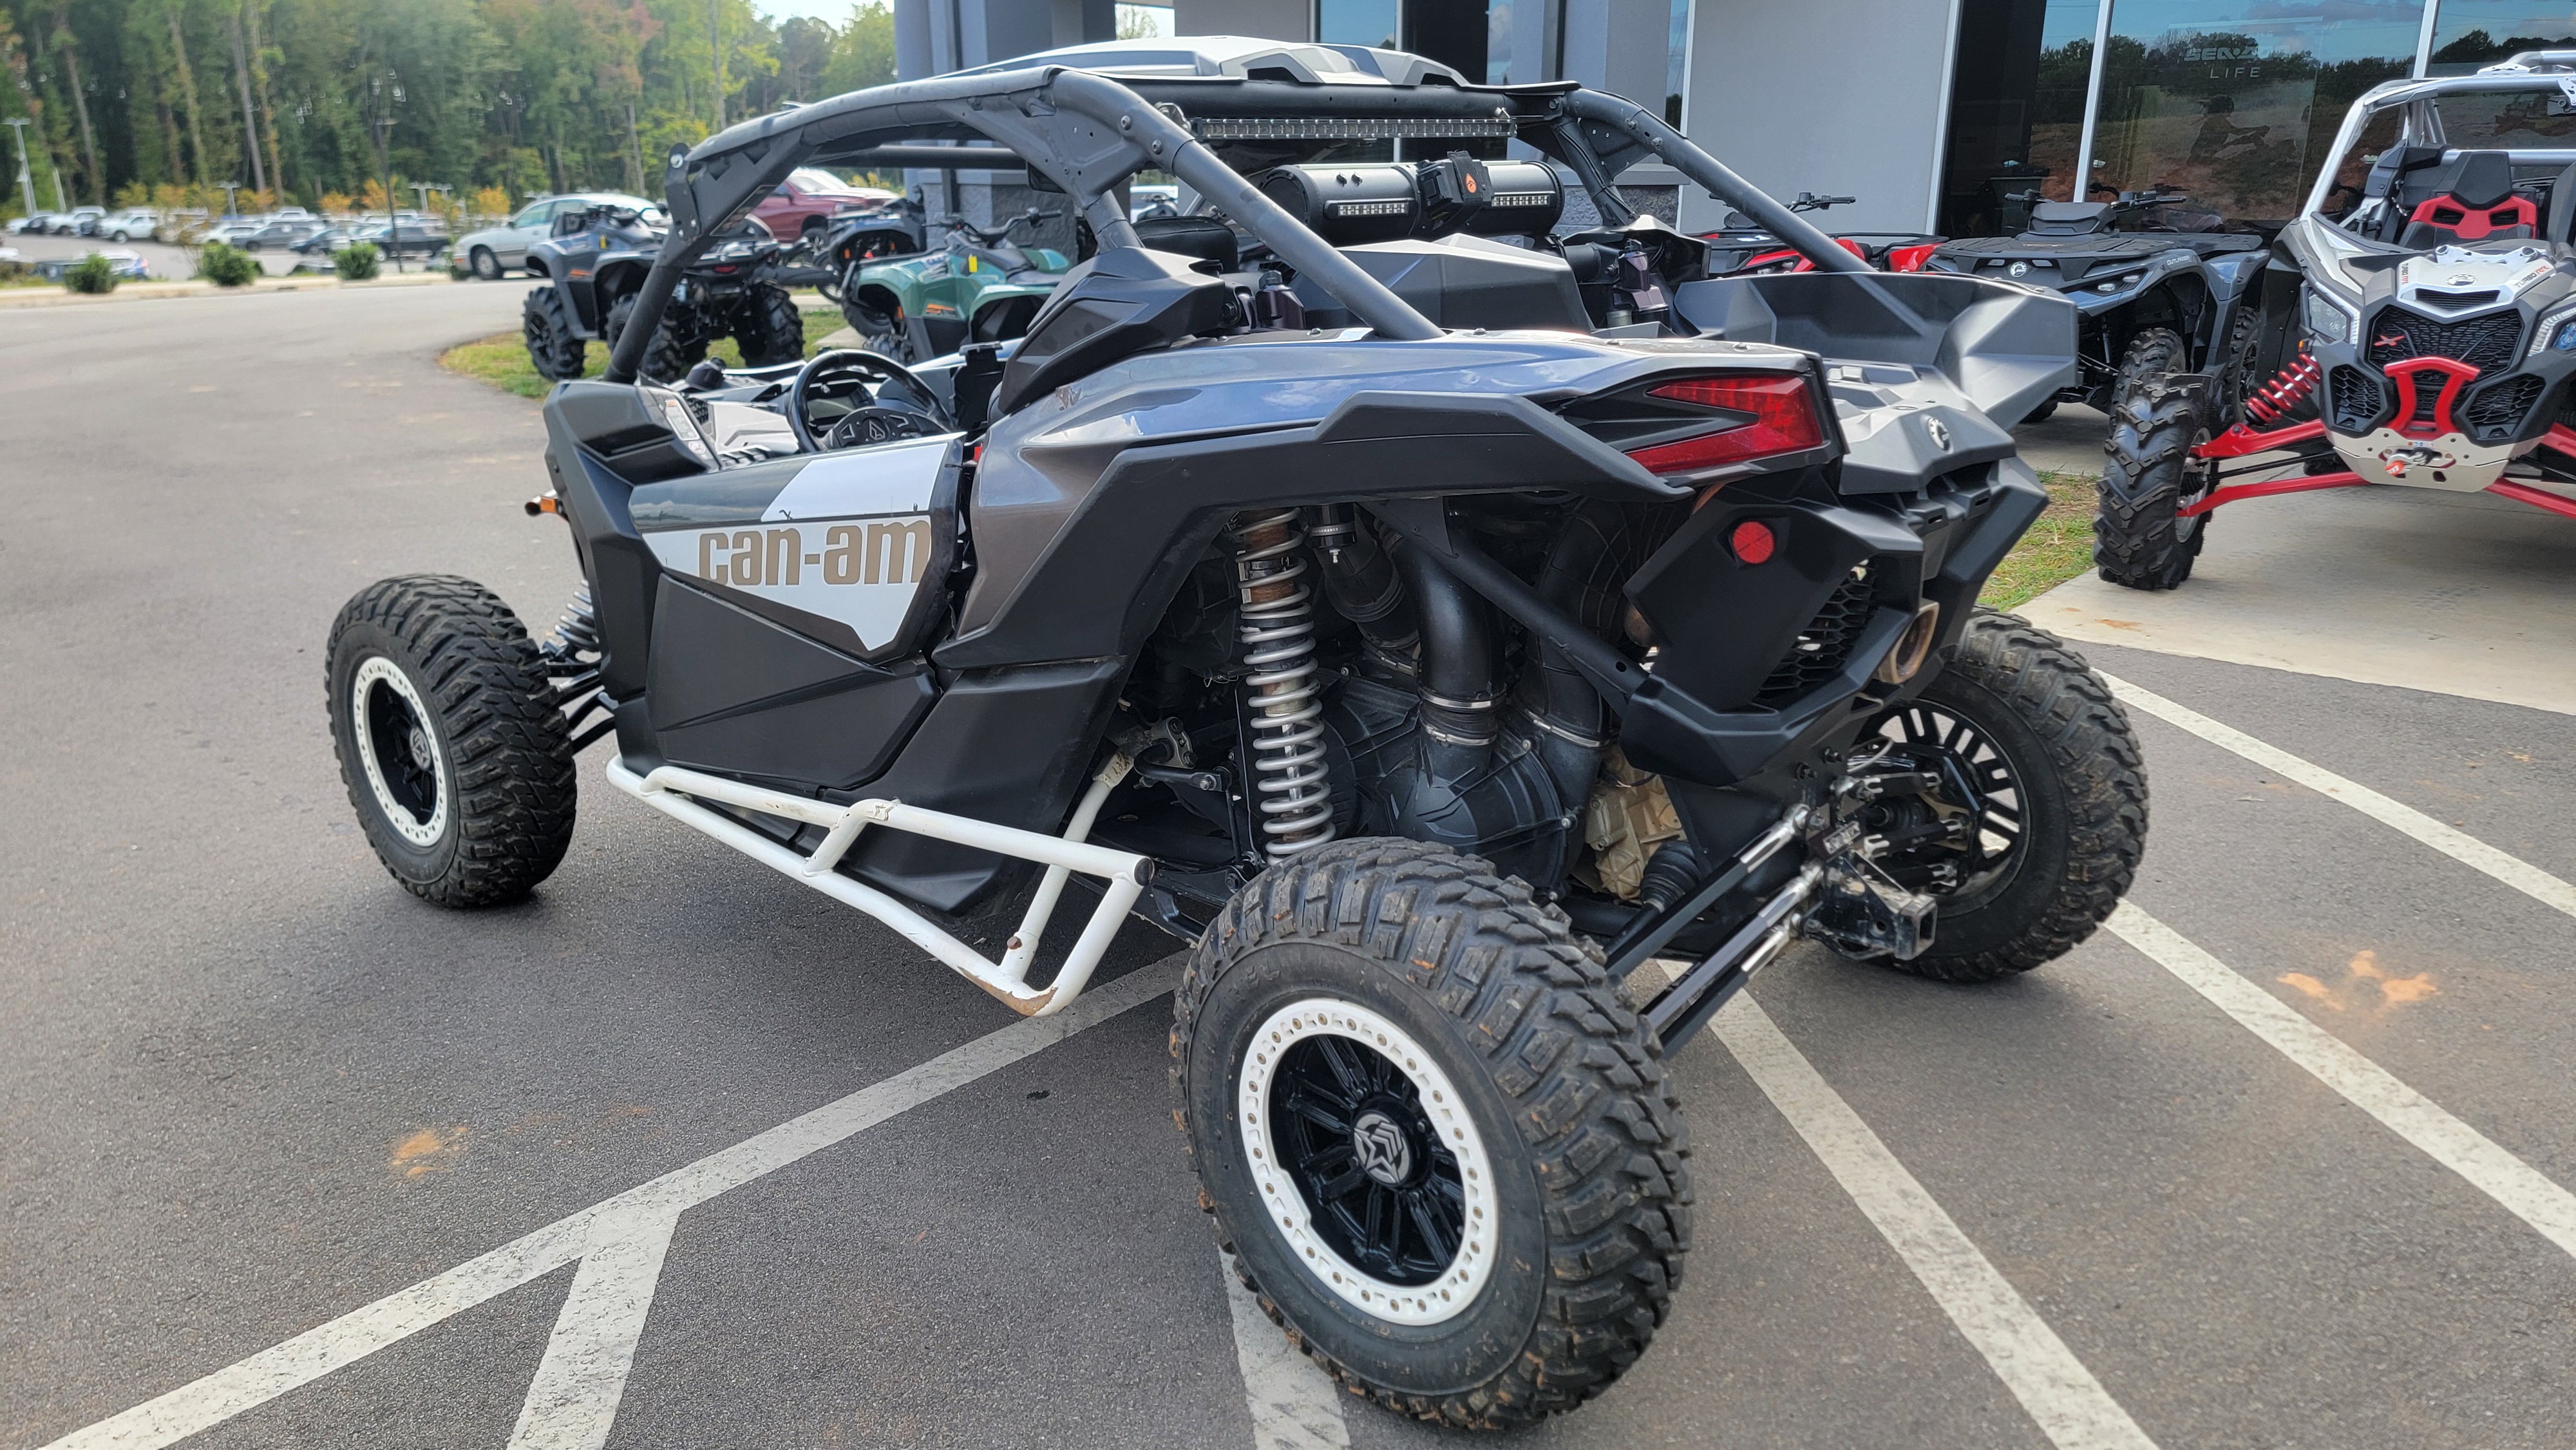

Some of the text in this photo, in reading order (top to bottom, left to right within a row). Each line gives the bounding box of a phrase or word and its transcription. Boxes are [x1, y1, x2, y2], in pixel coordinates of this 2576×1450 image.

[2210, 67, 2260, 79] LIFE
[2514, 265, 2550, 288] TURBO RR
[699, 520, 931, 586] can-am
